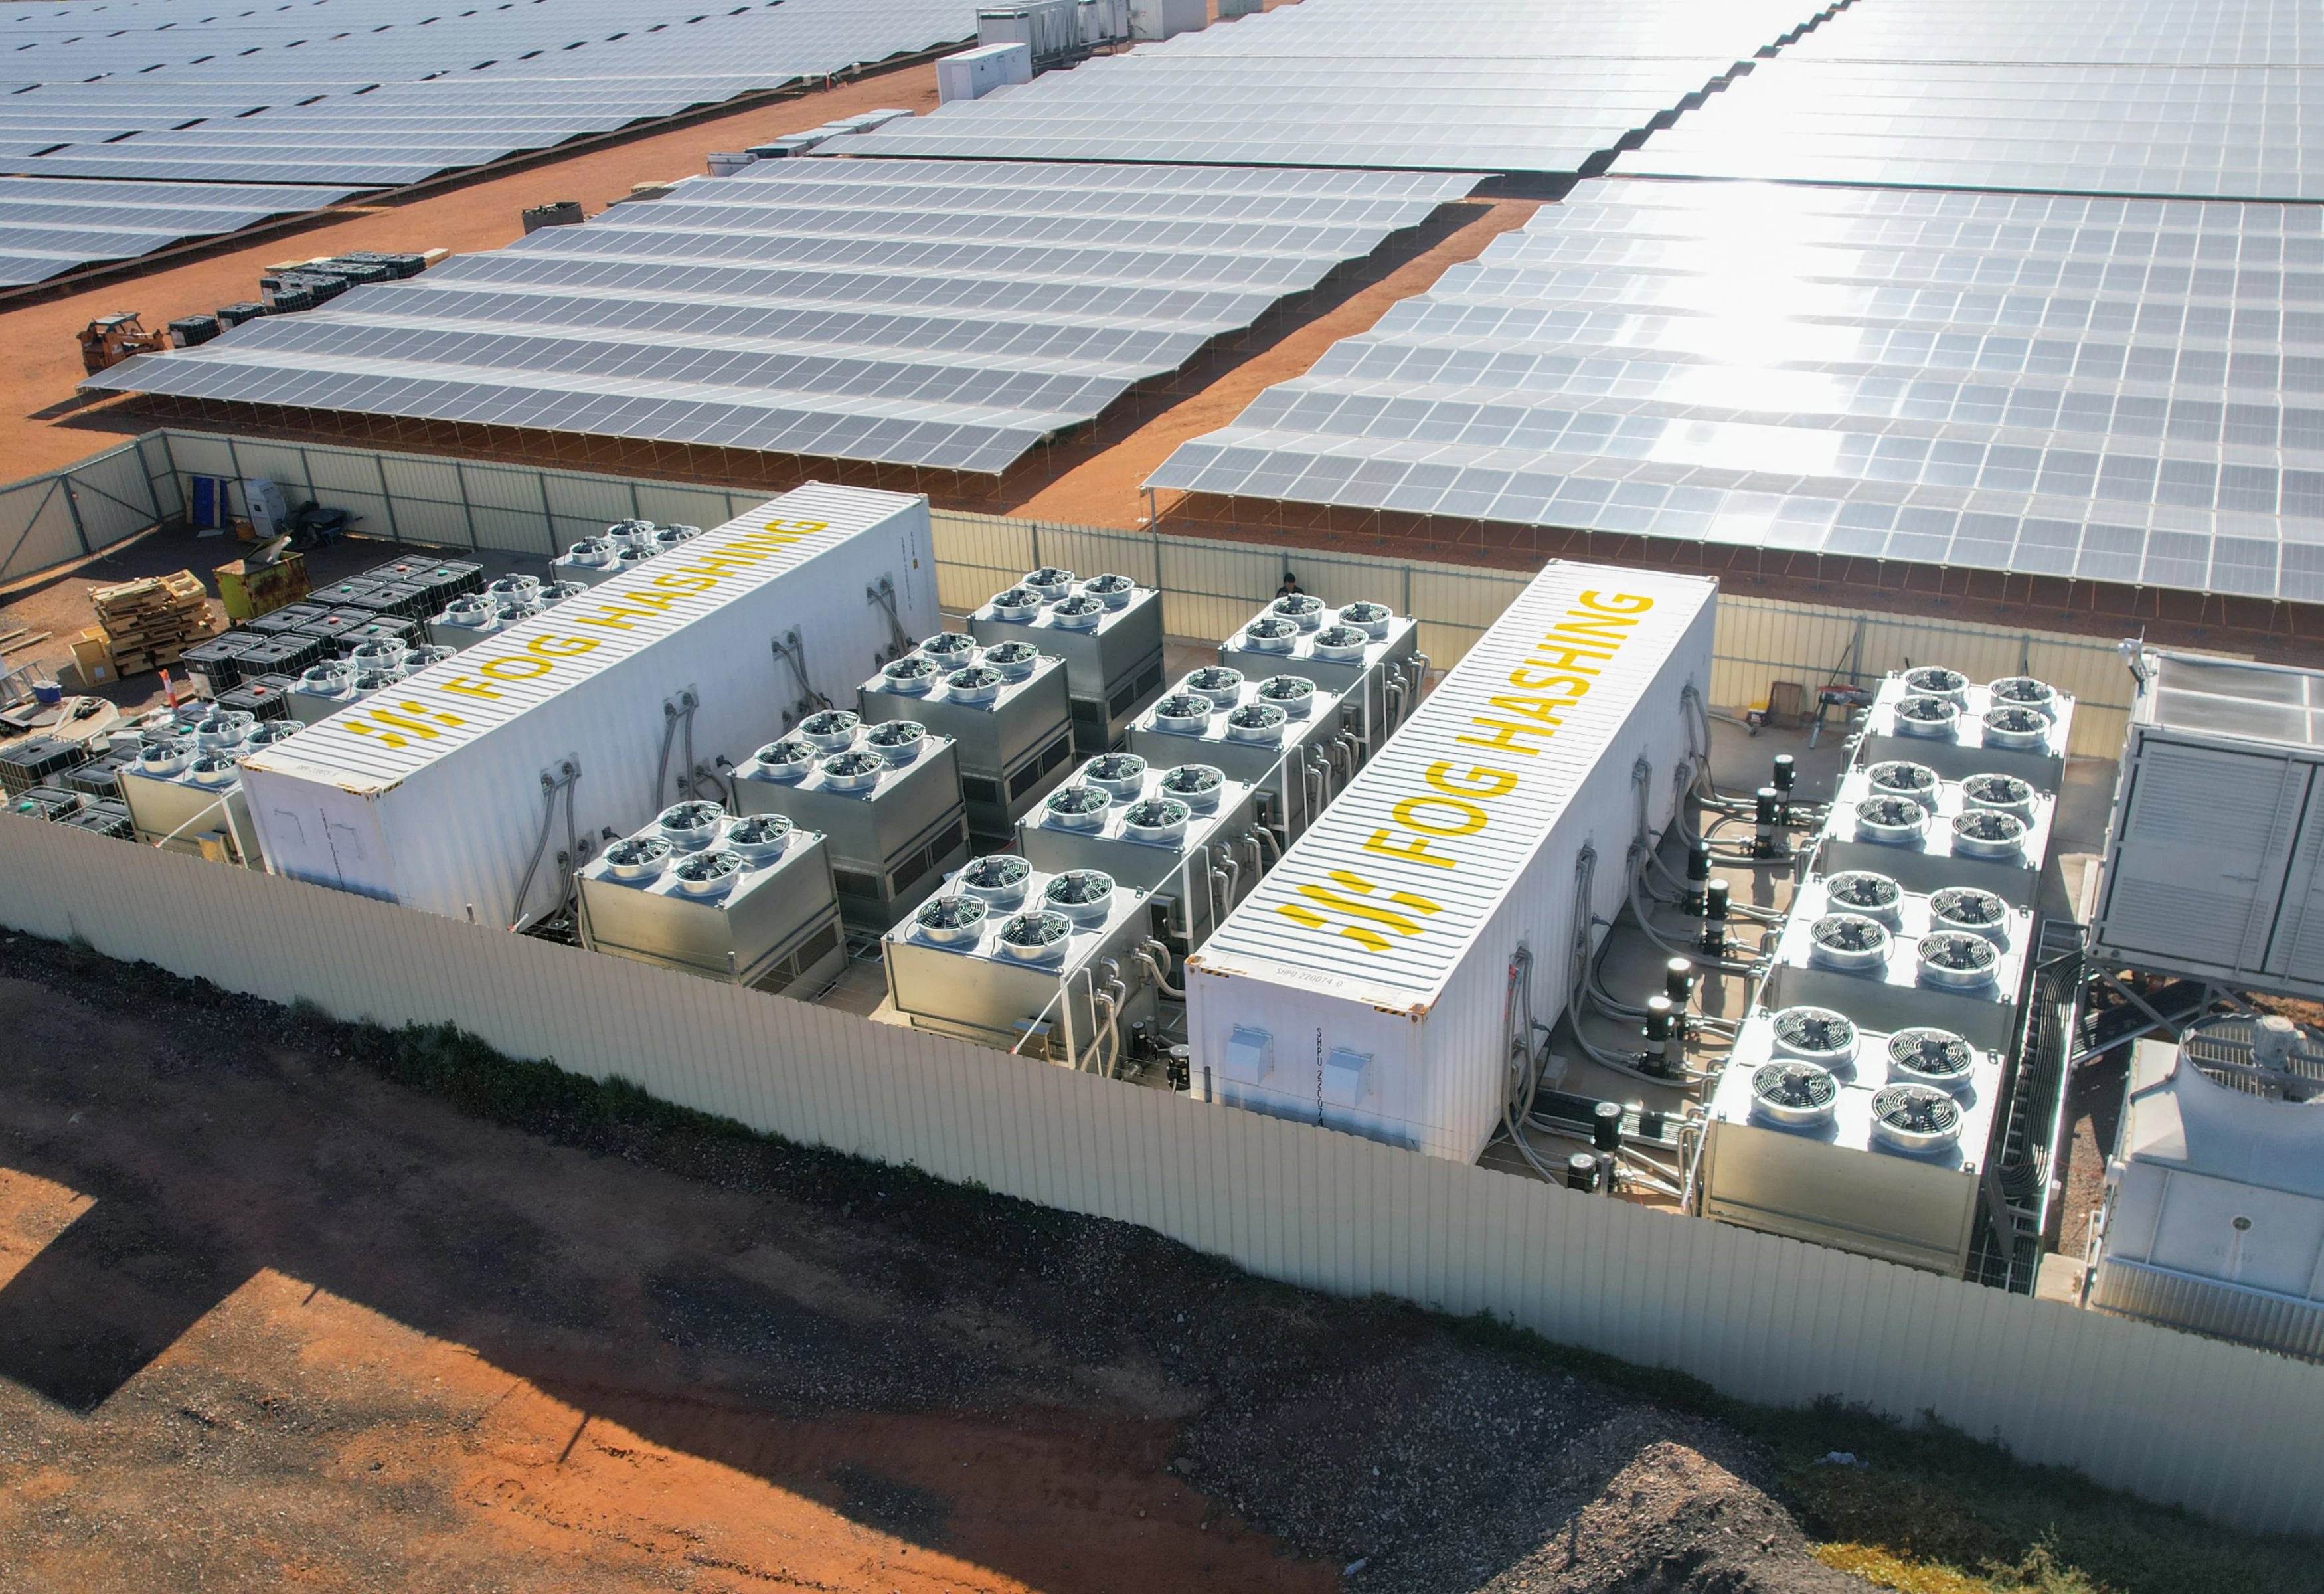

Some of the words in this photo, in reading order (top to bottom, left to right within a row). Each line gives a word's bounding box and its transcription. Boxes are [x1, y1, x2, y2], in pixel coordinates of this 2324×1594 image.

[440, 634, 601, 699] FOG
[574, 519, 829, 630] HASHING
[1362, 761, 1519, 869] FOG
[1455, 590, 1654, 756] HASHING
[1275, 968, 1297, 977] SHPU
[1298, 972, 1333, 984] 220074
